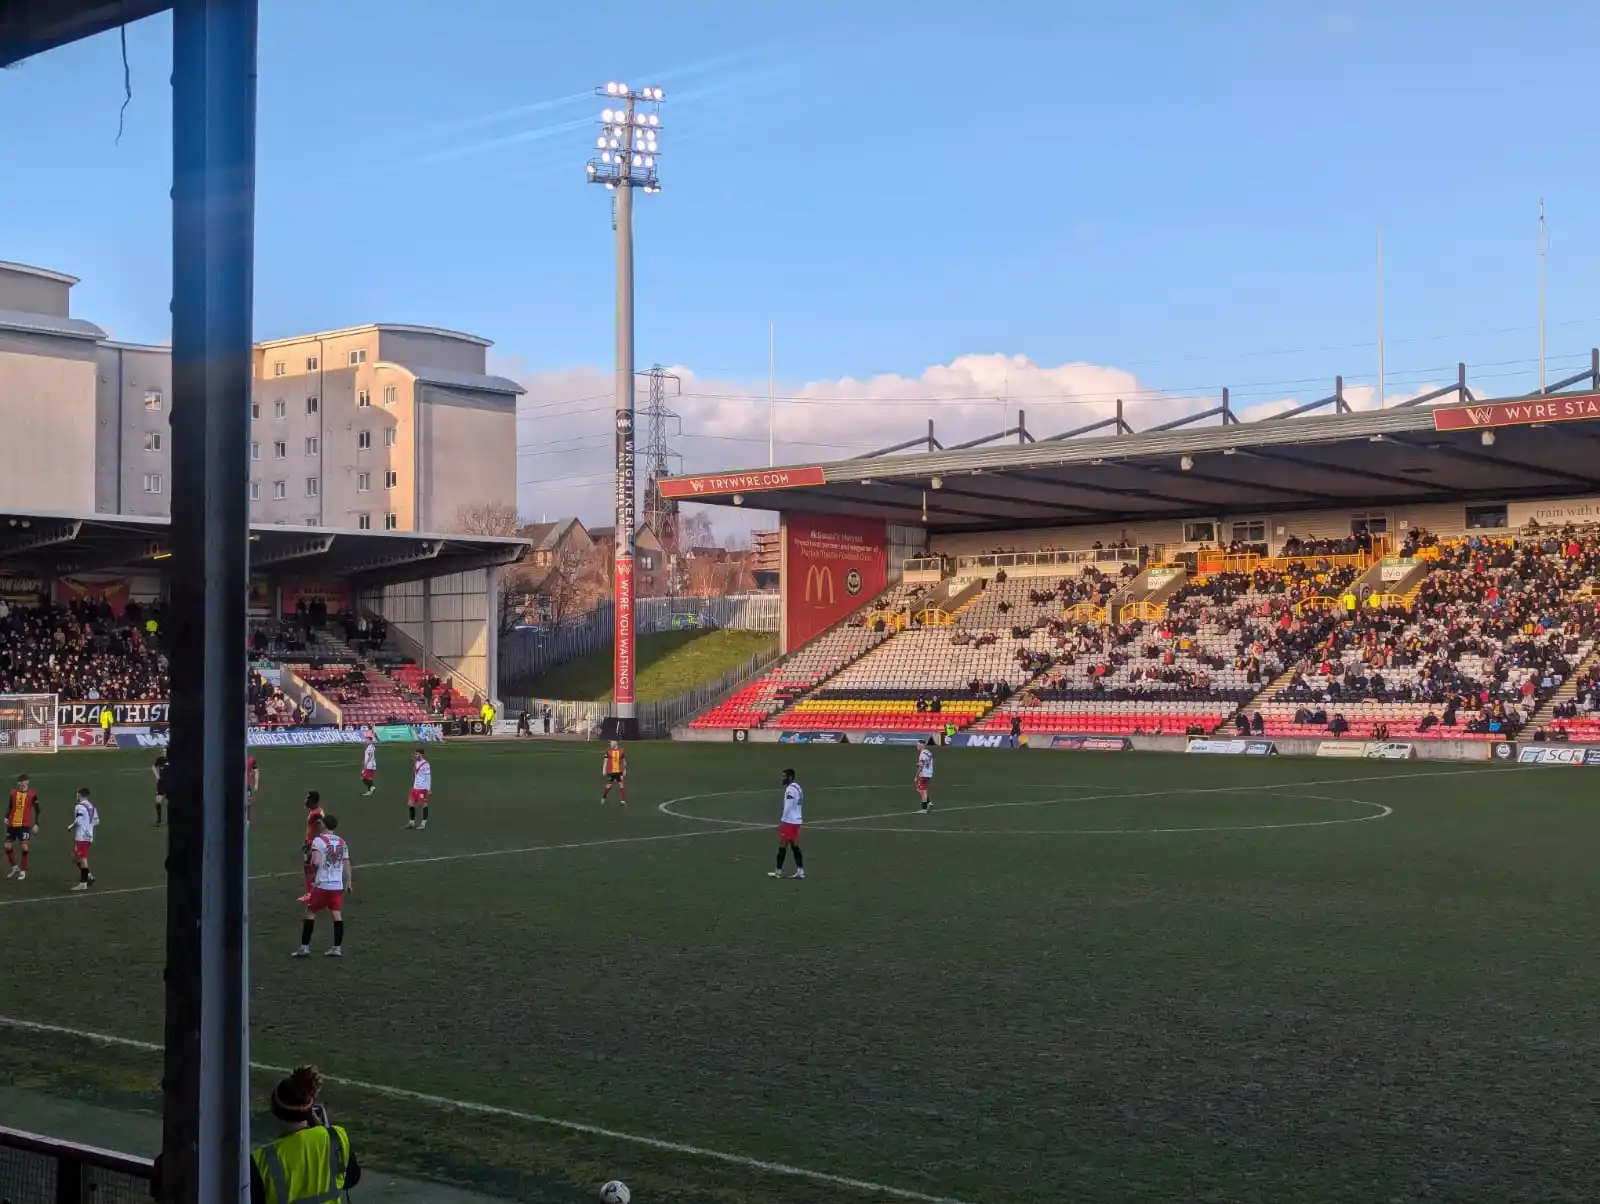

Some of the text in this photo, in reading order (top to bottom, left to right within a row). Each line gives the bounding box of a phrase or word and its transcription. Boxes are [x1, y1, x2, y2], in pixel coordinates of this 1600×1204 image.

[1505, 403, 1557, 419] WYRE
[1565, 400, 1598, 415] STA
[625, 440, 634, 536] WRIGHTKERR
[710, 474, 789, 489] TRYWYRE.COM
[619, 580, 629, 690] WYRE YOU WAITING?
[247, 732, 291, 746] FORREST
[291, 731, 341, 744] PRECISION
